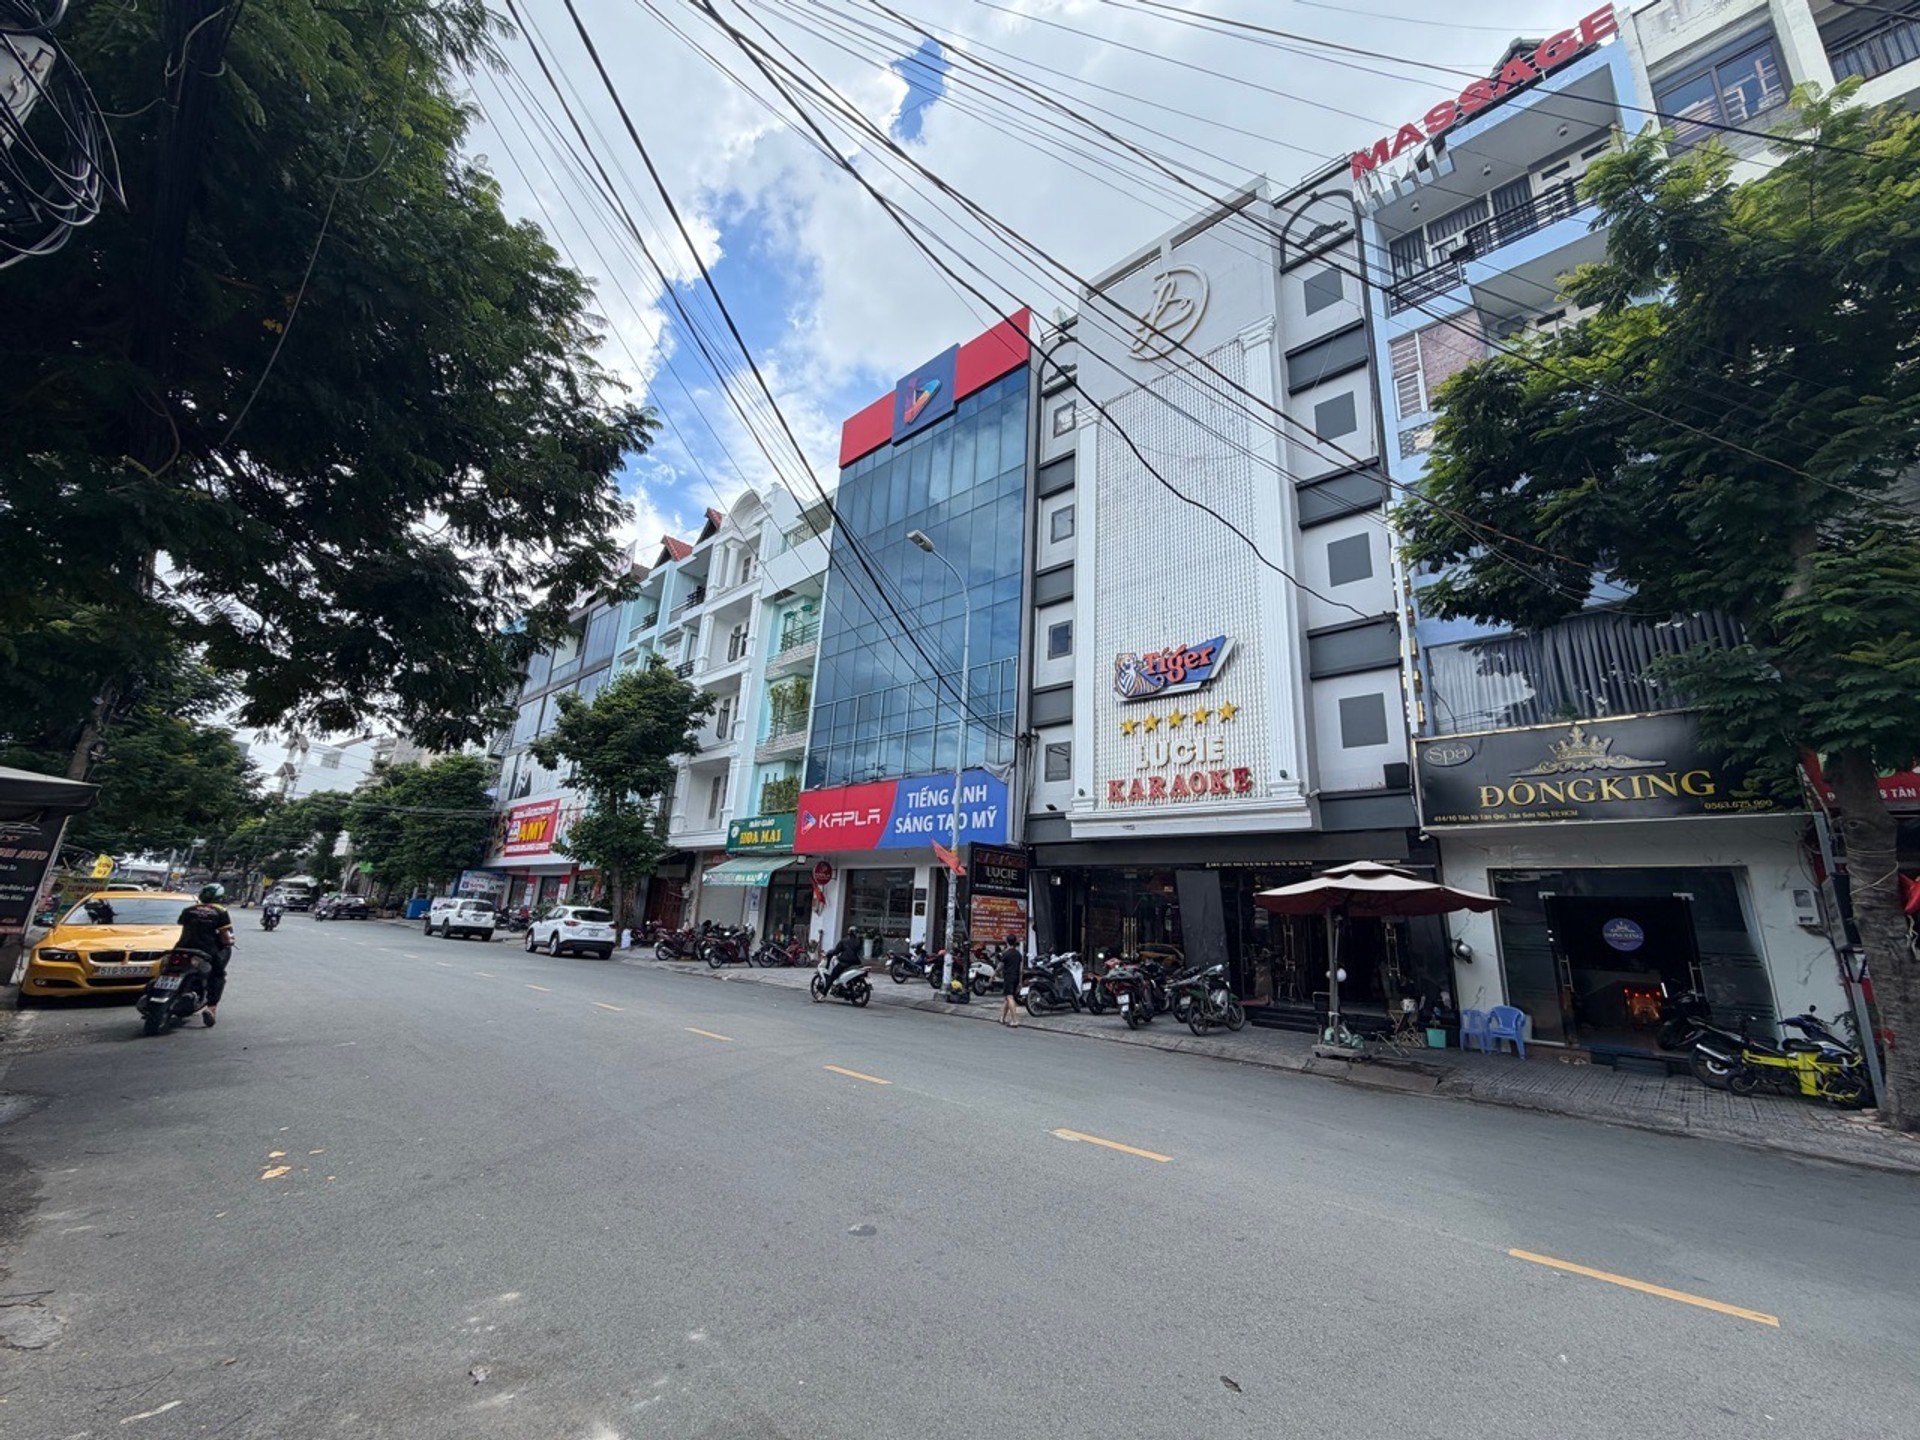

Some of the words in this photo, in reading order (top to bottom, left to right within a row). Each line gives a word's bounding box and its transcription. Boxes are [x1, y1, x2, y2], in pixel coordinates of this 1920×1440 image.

[1350, 2, 1618, 180] MASSAGE
[1142, 643, 1214, 683] Tiger
[1135, 734, 1226, 770] LUCIE
[1429, 745, 1468, 765] Spa
[907, 785, 949, 808] TIẾNG
[1107, 766, 1254, 803] KARAOKE
[1479, 769, 1716, 809] ĐÔNGKING
[1890, 786, 1917, 798] TÂN
[819, 808, 881, 829] KAPLA
[895, 814, 933, 834] SÁNG
[972, 805, 998, 830] MỸ
[984, 865, 1018, 881] LUCIE
